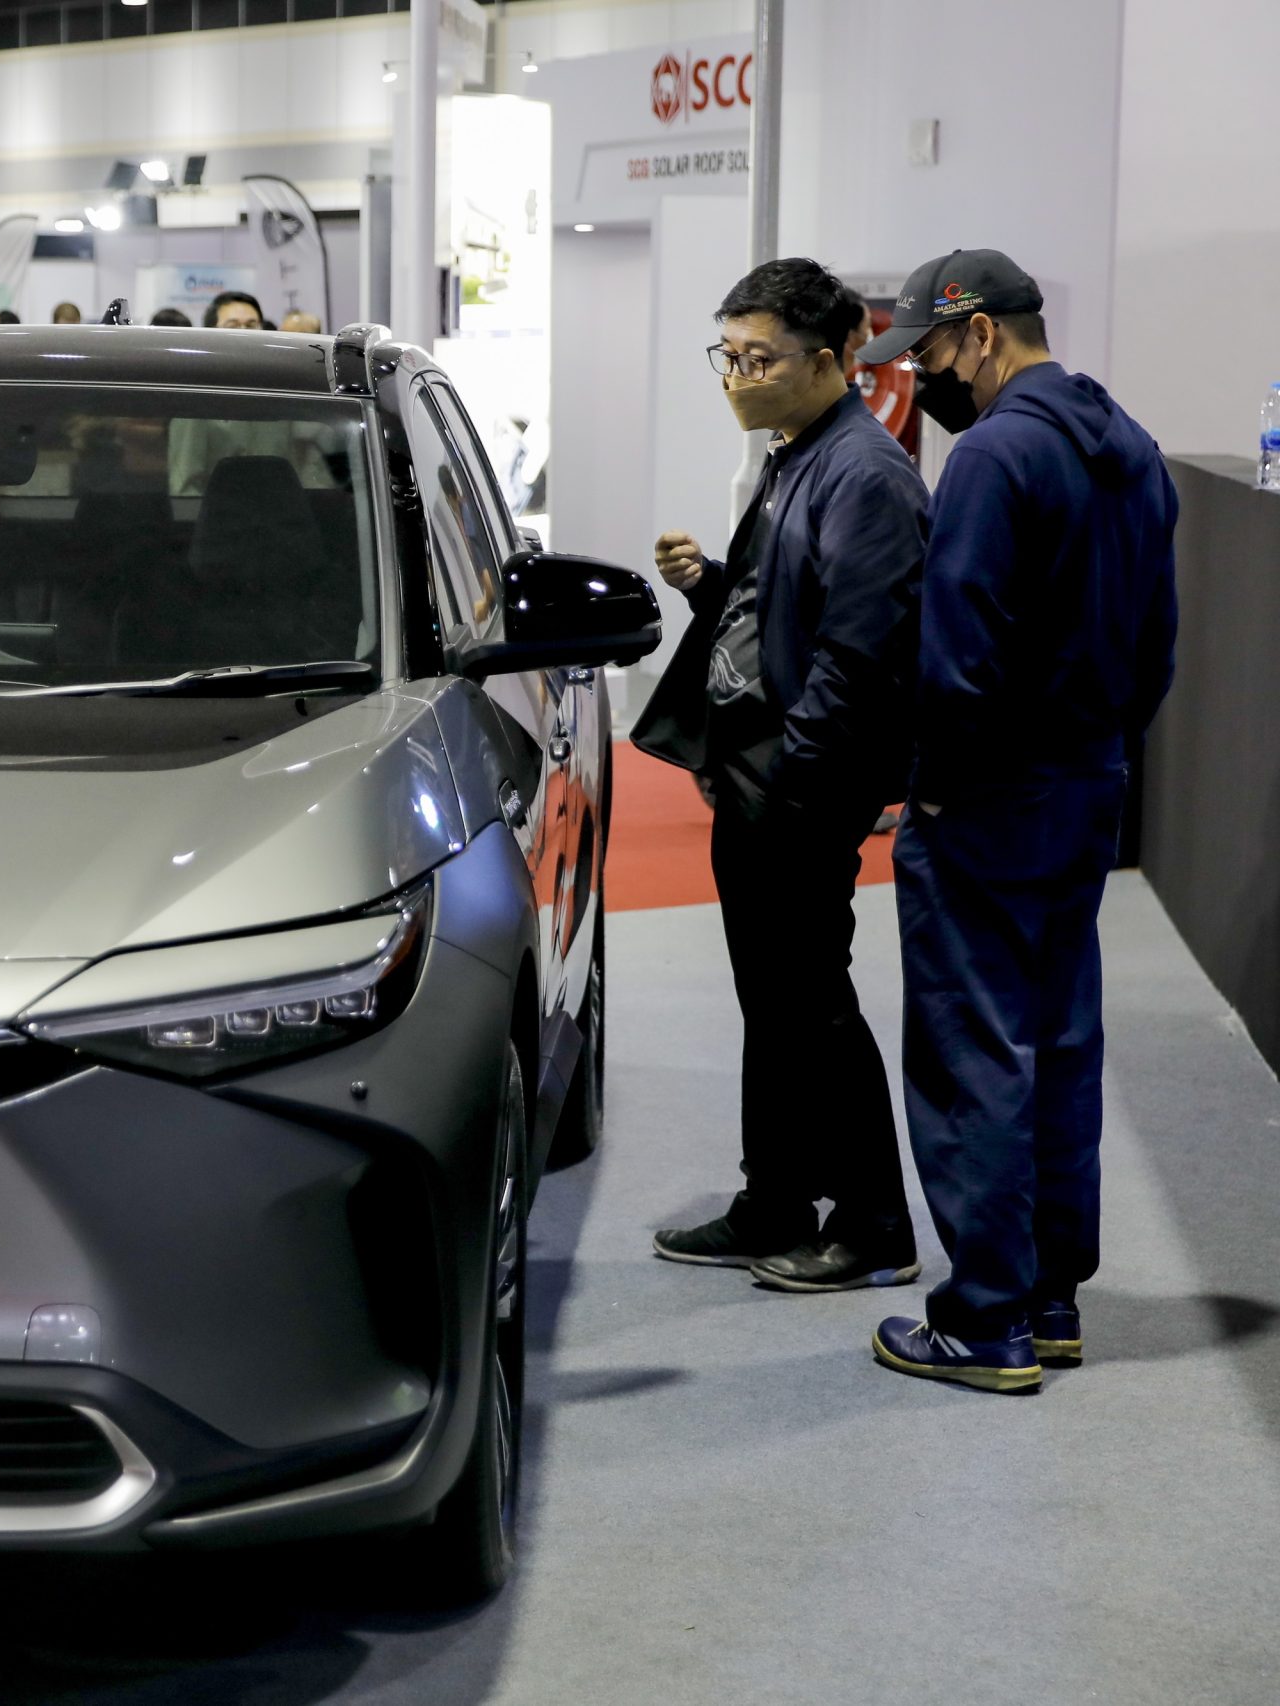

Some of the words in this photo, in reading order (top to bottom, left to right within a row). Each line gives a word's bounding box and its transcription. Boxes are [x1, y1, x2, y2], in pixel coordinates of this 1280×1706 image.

[653, 155, 689, 177] SOLAR
[933, 303, 957, 313] AMATA
[957, 297, 983, 307] SPRING
